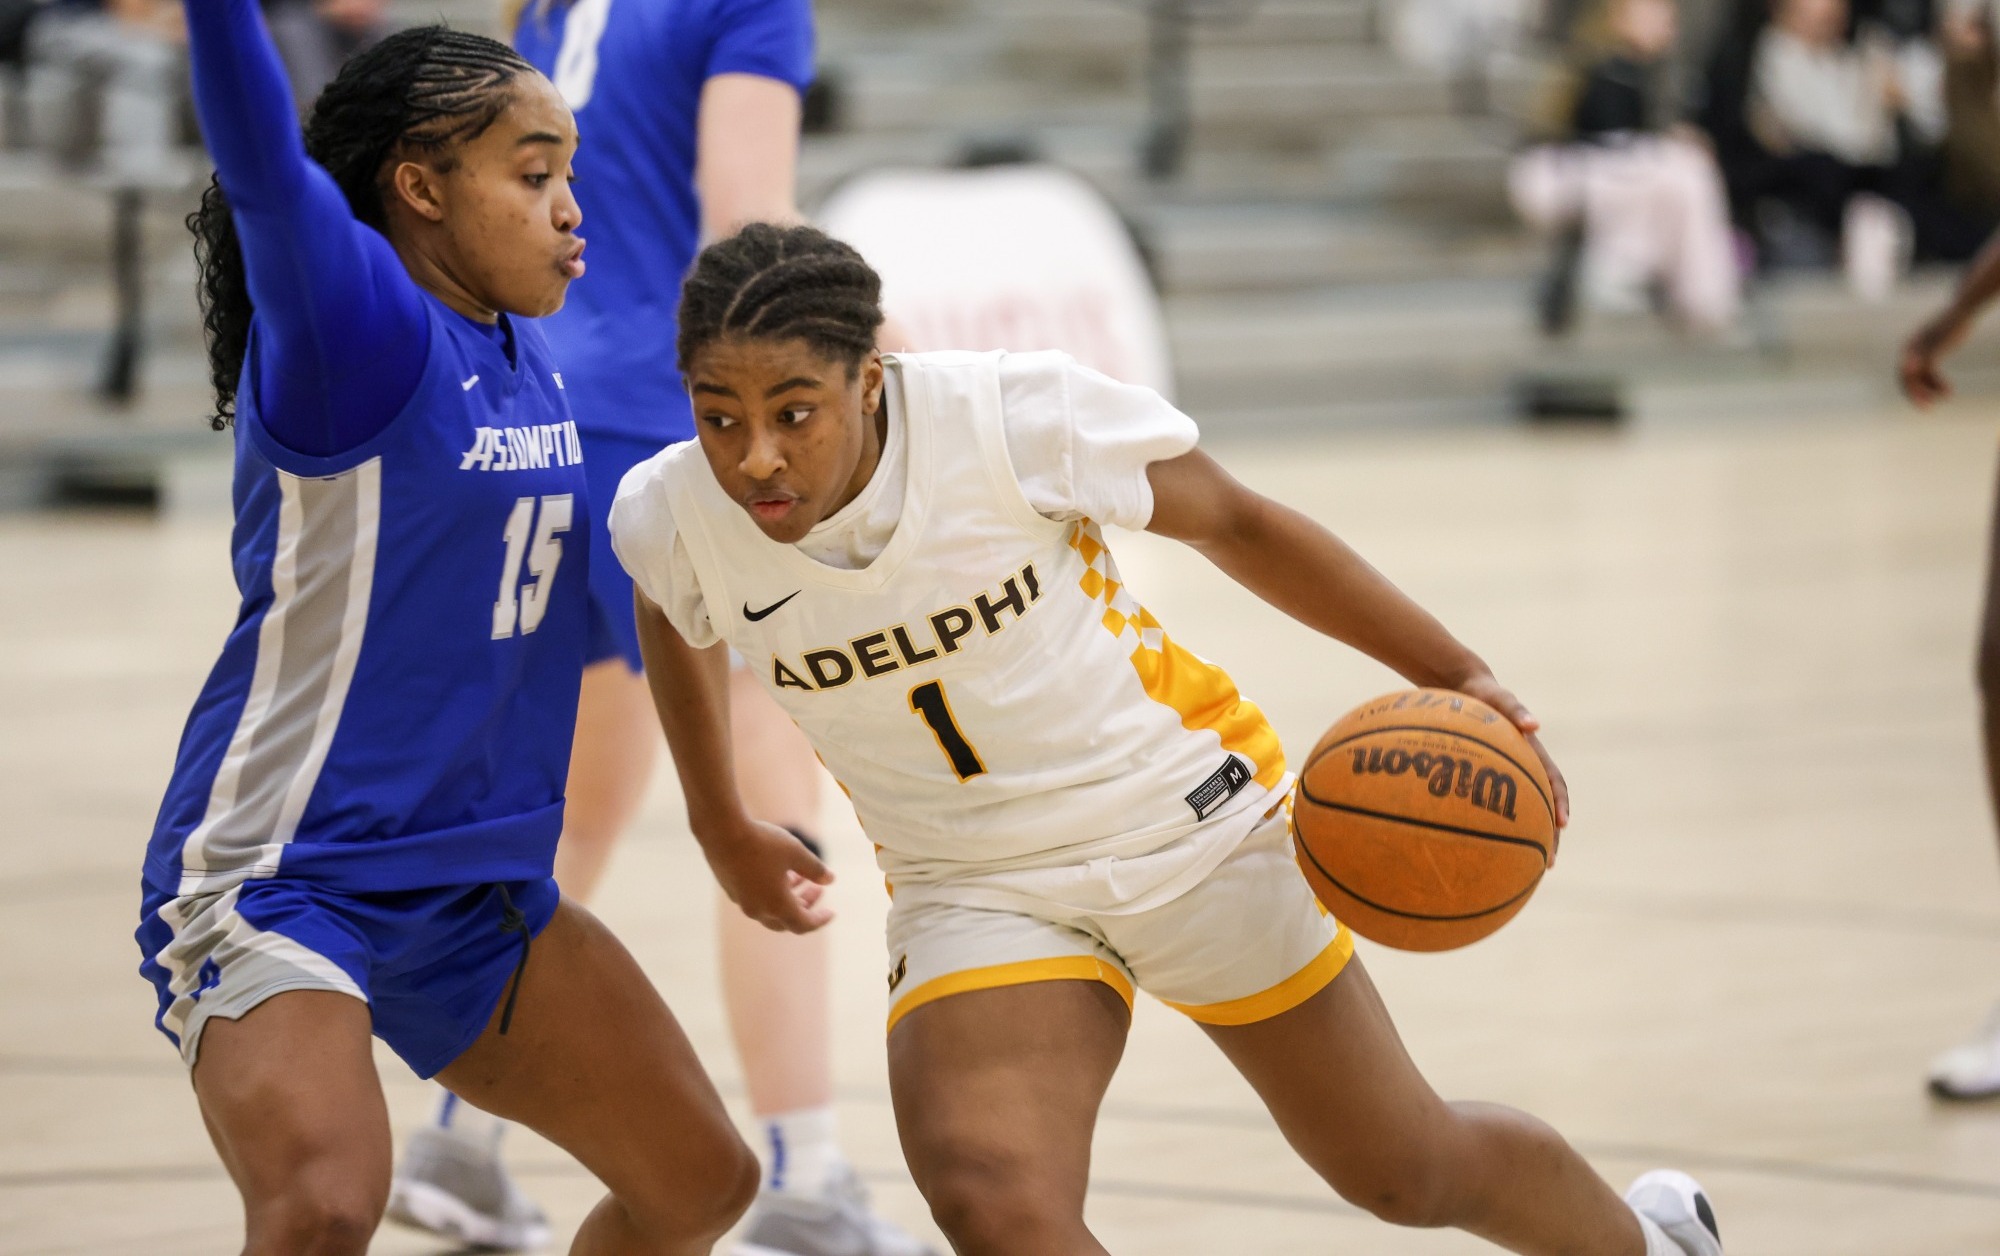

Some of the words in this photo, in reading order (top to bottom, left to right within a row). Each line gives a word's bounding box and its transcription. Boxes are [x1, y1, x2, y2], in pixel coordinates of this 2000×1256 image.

[458, 420, 584, 471] ASSUMPTIO
[491, 493, 574, 640] 15
[772, 560, 1044, 692] ADELPHI
[907, 678, 988, 784] 1
[1229, 767, 1242, 784] M
[1352, 747, 1516, 821] Wilson
